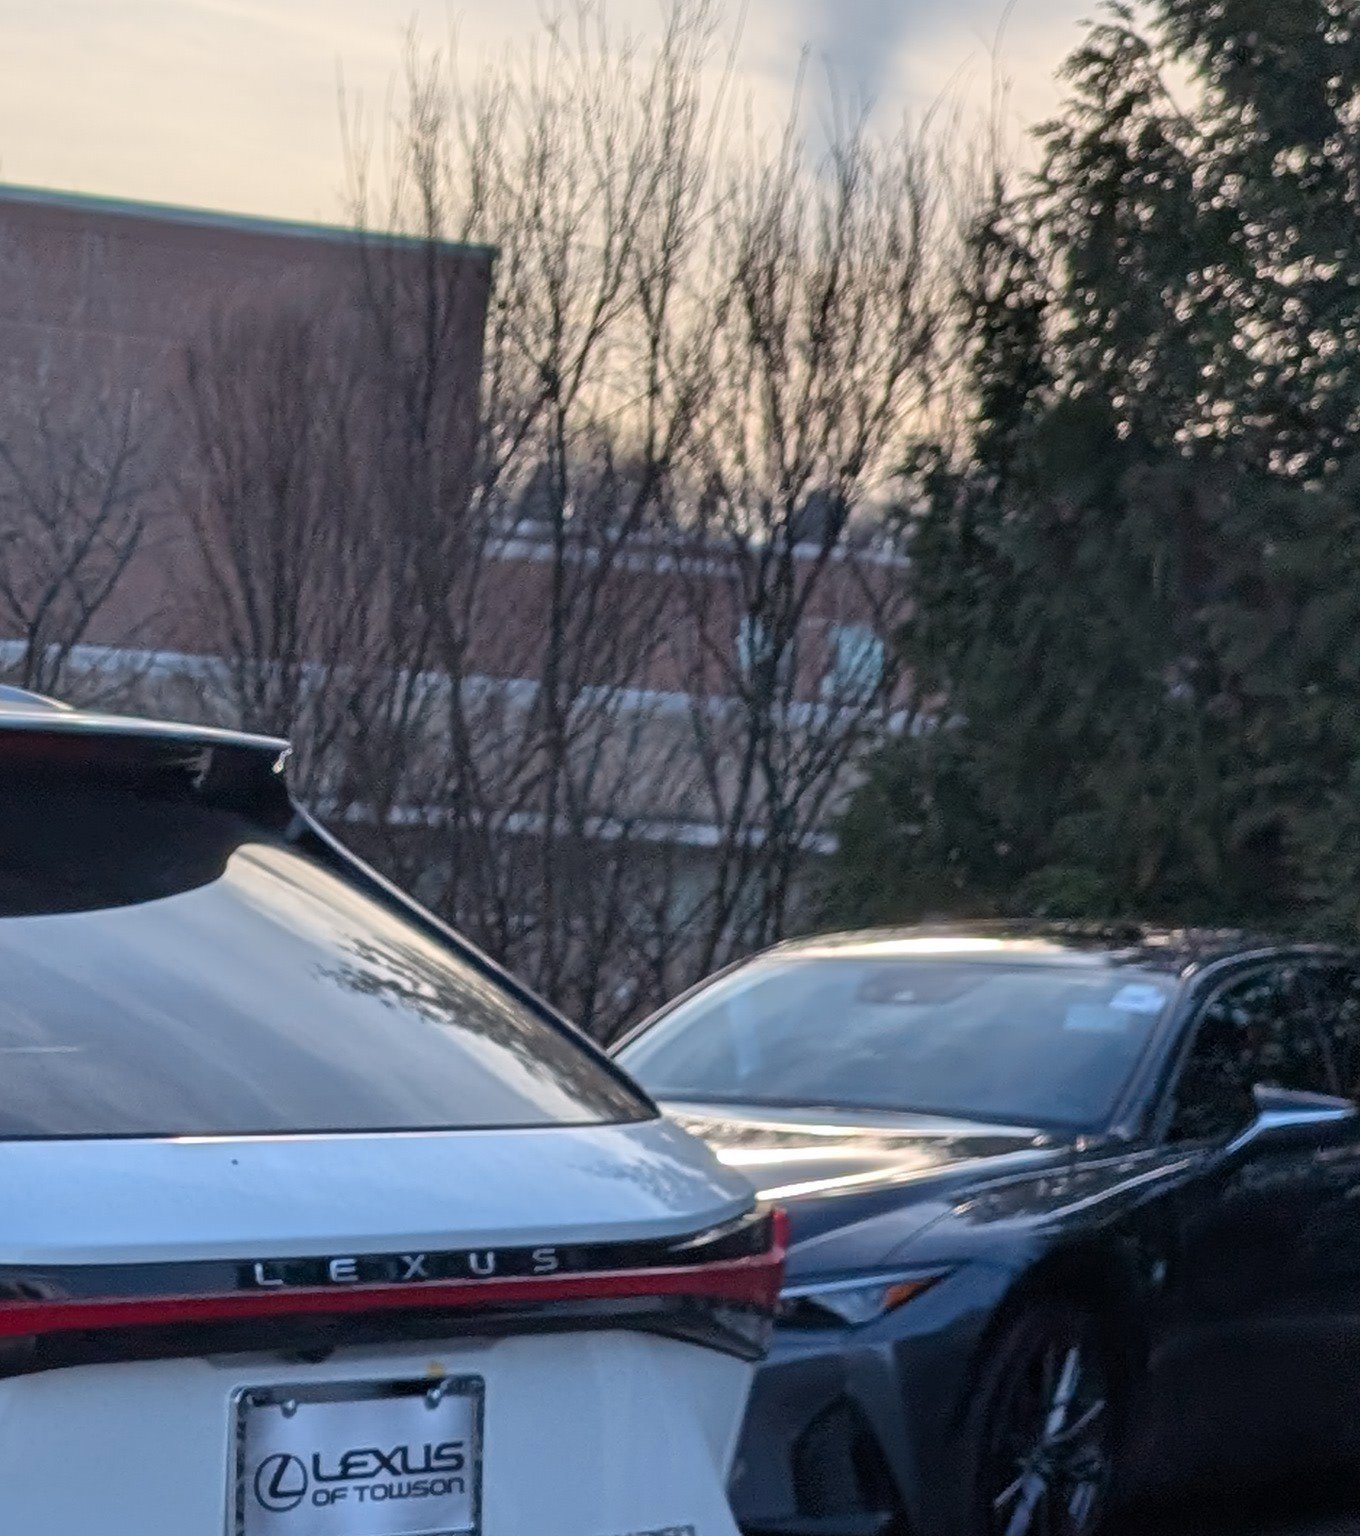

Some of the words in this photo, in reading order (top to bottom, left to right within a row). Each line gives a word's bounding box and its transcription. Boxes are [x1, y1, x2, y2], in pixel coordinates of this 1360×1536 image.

[253, 1247, 559, 1287] LEXUS
[312, 1440, 465, 1482] LEXUS
[312, 1486, 348, 1507] OF
[353, 1476, 465, 1503] TOWSON
